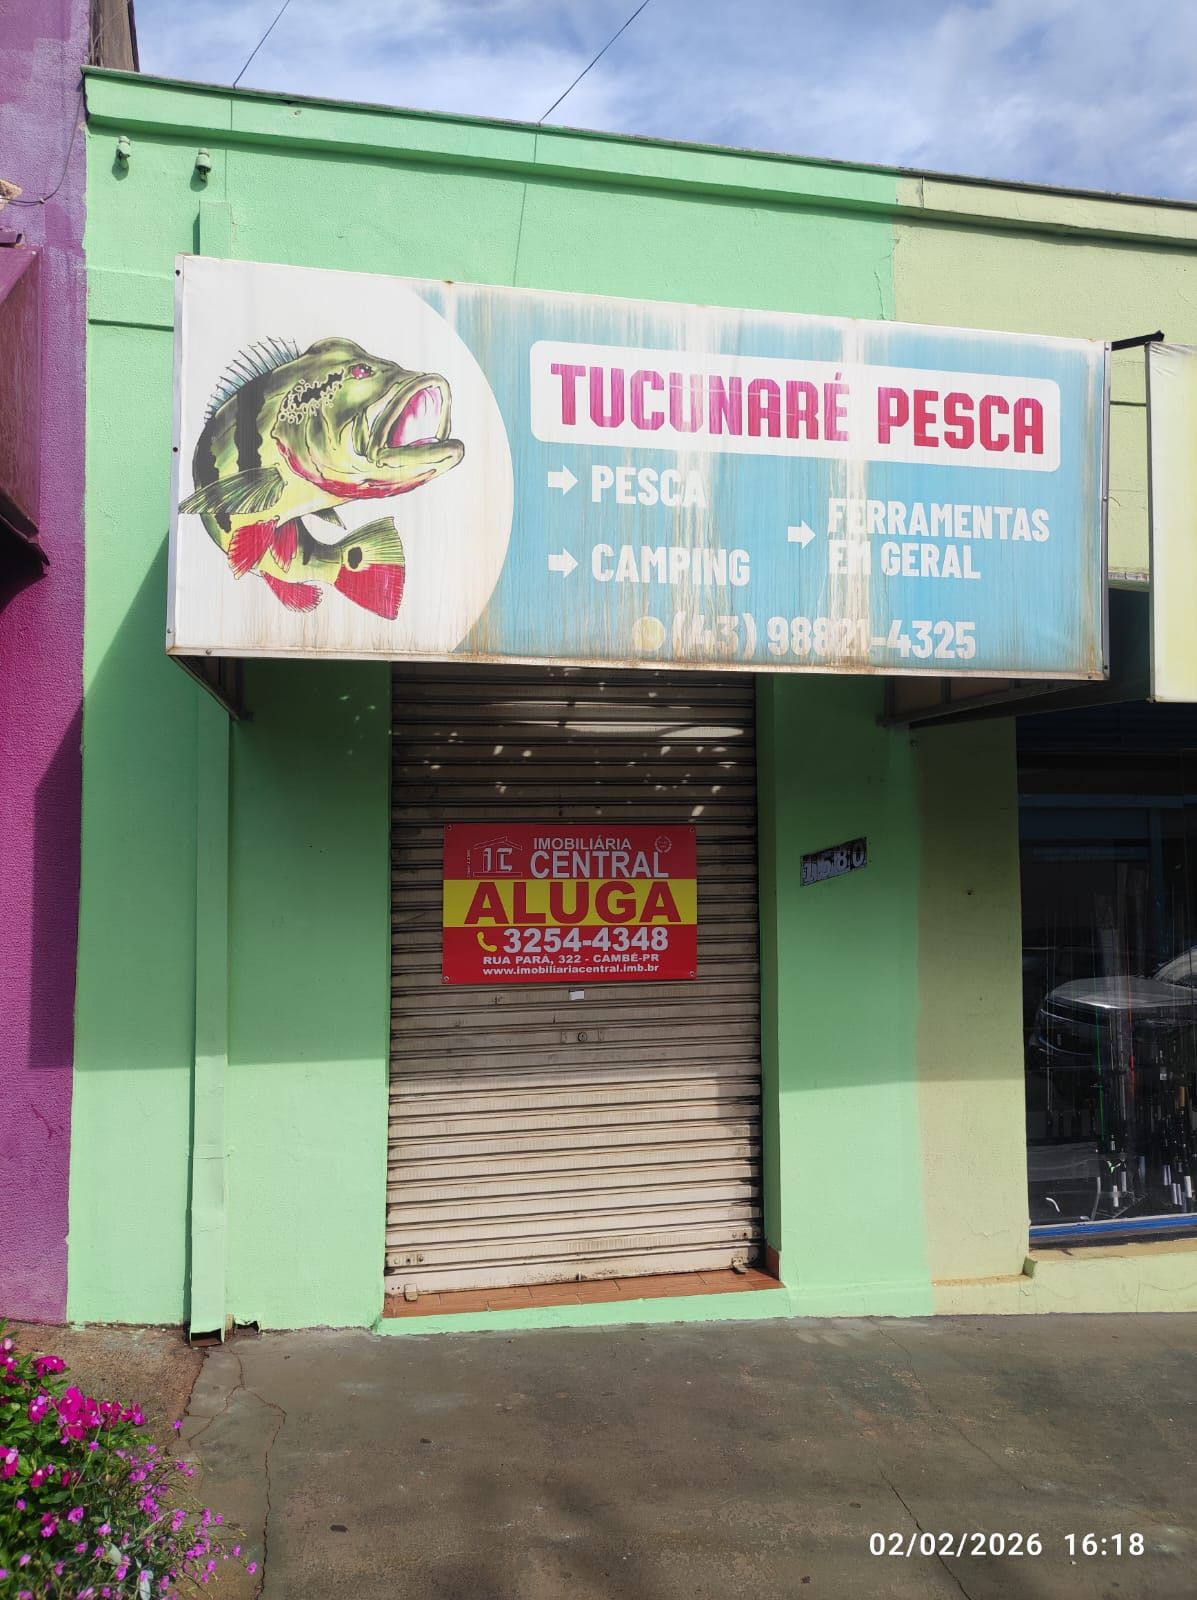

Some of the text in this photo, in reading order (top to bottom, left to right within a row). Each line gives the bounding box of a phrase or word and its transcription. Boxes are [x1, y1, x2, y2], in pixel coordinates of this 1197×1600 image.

[550, 362, 1044, 455] TUCUNARÉ PESCA
[591, 464, 707, 509] PESCA
[828, 497, 1050, 543] FERRAMENTAS
[591, 543, 750, 587] CAMPING
[828, 539, 981, 579] EM GERAL
[533, 835, 632, 850] IMOBILIÁRIA
[530, 851, 669, 879] CENTRAL
[464, 880, 682, 925] ALUGA
[483, 956, 511, 965] RUA
[558, 954, 582, 963] 322
[593, 952, 660, 963] CAMBÉ-PR
[503, 926, 669, 954] 3254-4348
[483, 963, 660, 976] www.imobiliariacentral.imb.br
